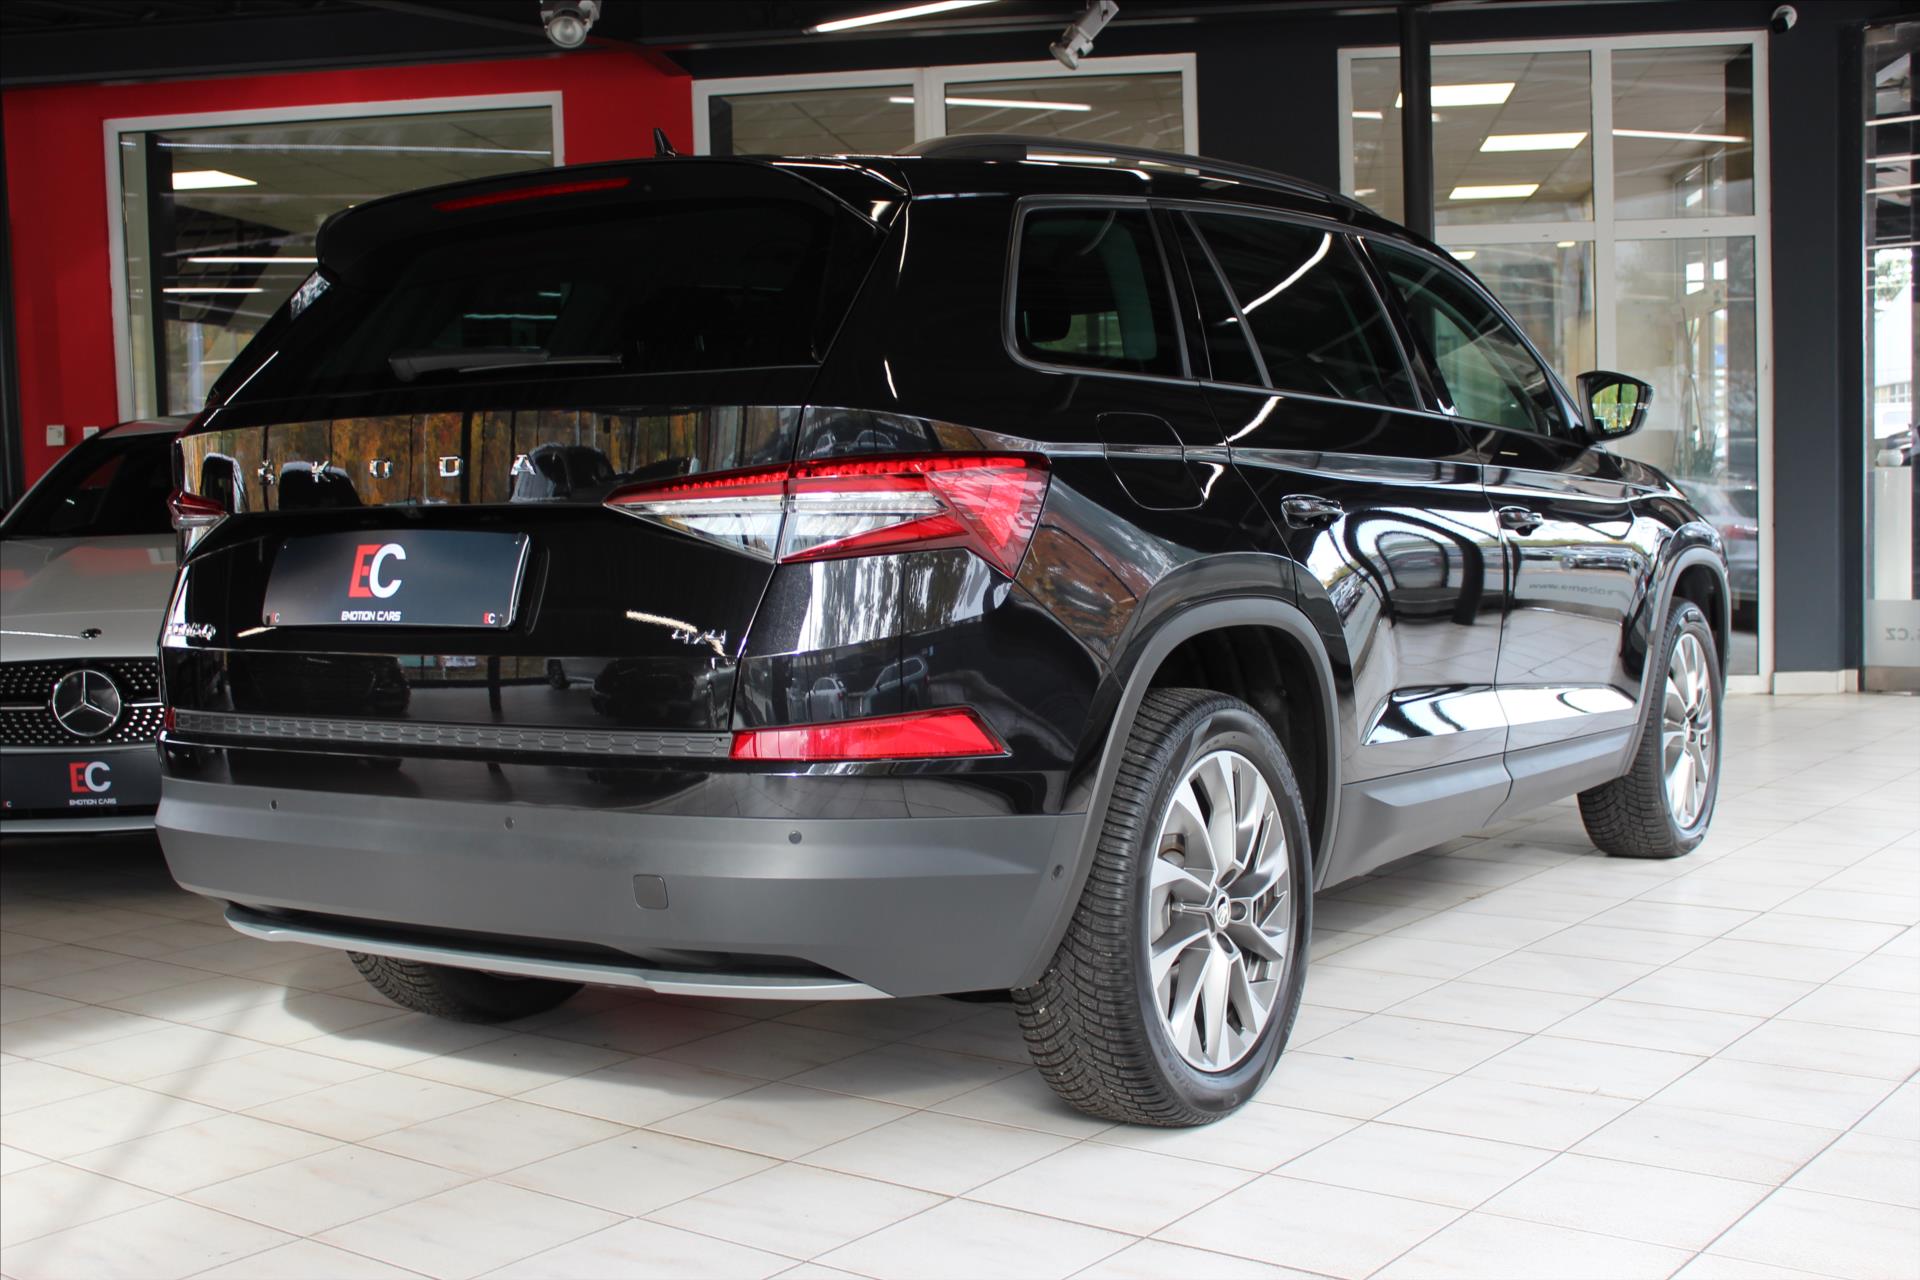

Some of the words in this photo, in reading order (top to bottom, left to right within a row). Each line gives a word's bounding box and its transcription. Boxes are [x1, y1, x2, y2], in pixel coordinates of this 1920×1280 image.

[348, 543, 406, 599] EC
[341, 609, 376, 621] EMOTION
[377, 609, 401, 621] CARS
[69, 761, 111, 793] EC
